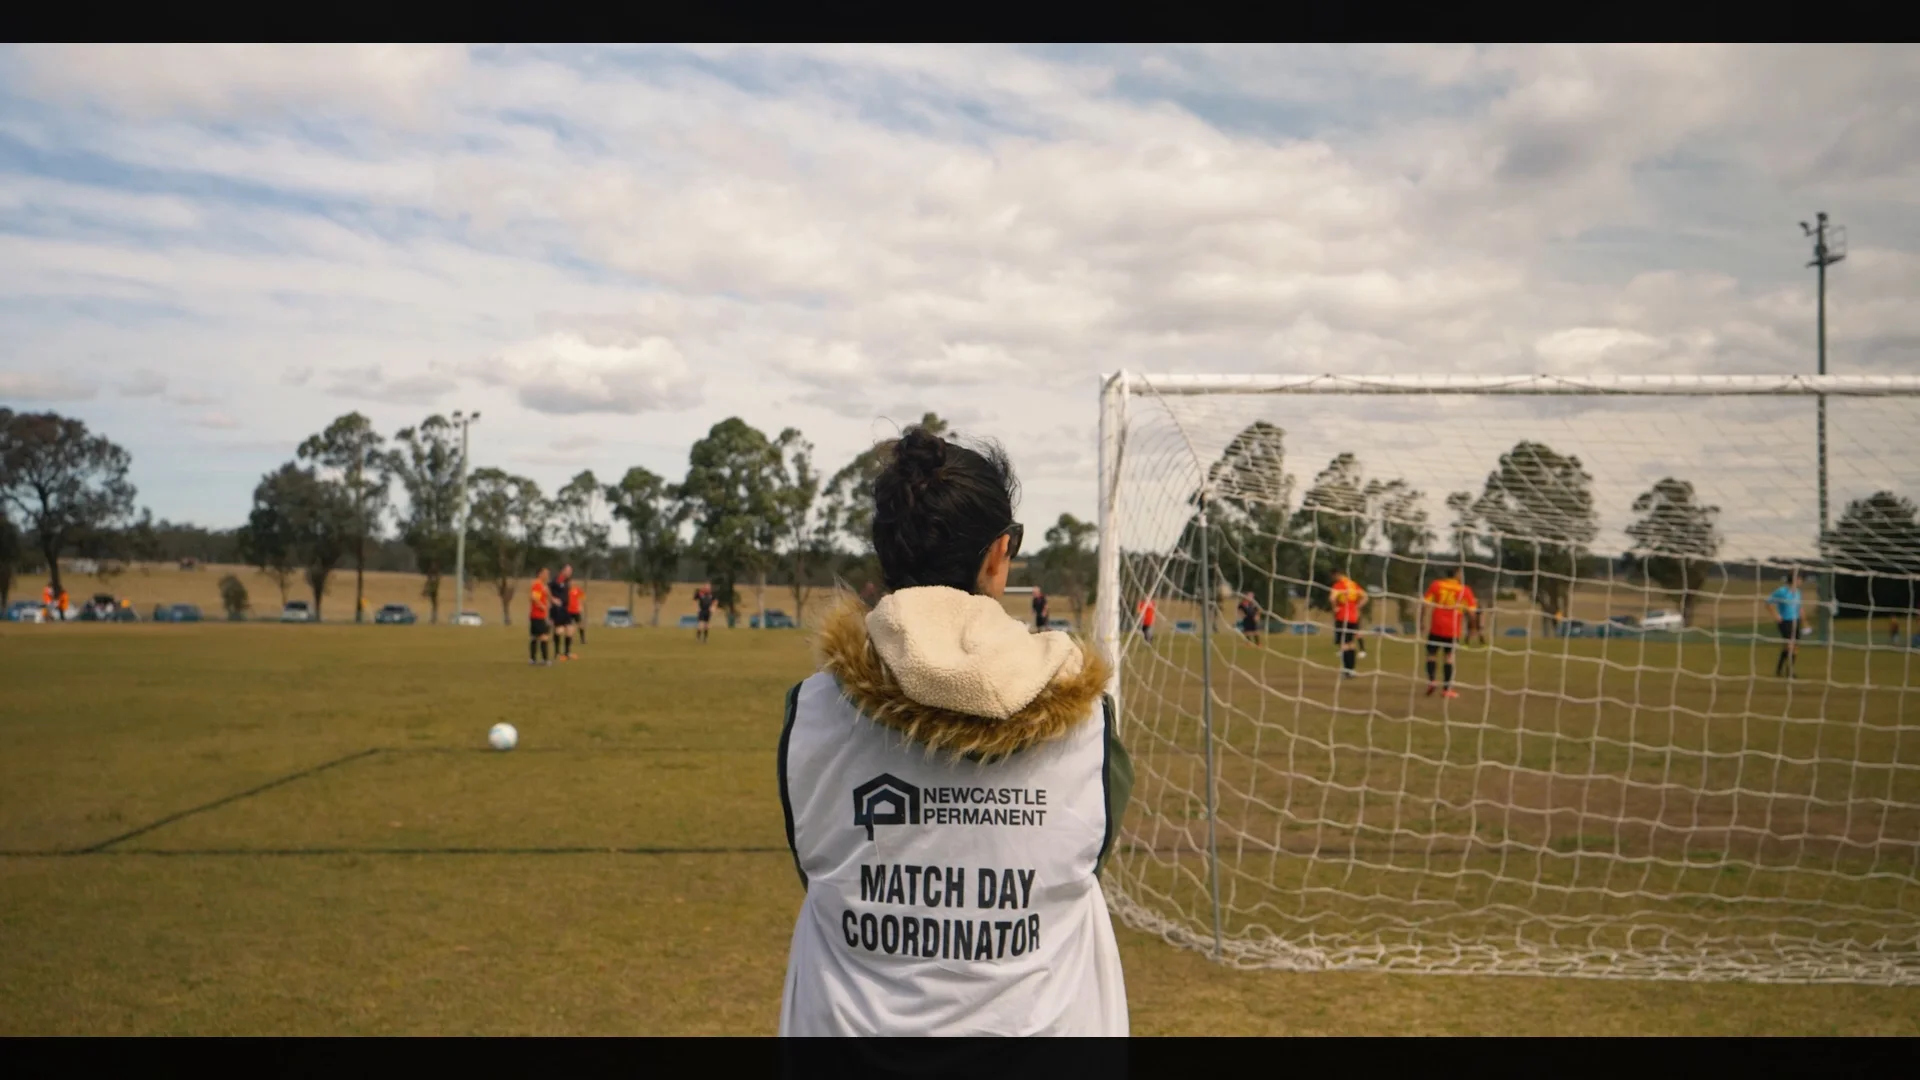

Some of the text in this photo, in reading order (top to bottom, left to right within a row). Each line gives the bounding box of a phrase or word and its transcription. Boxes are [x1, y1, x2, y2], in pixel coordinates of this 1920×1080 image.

[923, 787, 1047, 805] NEWCASTLE
[923, 808, 1047, 826] PERMANENT
[860, 864, 1036, 909] MATCH DAY
[842, 909, 1040, 961] COORDINATOR
